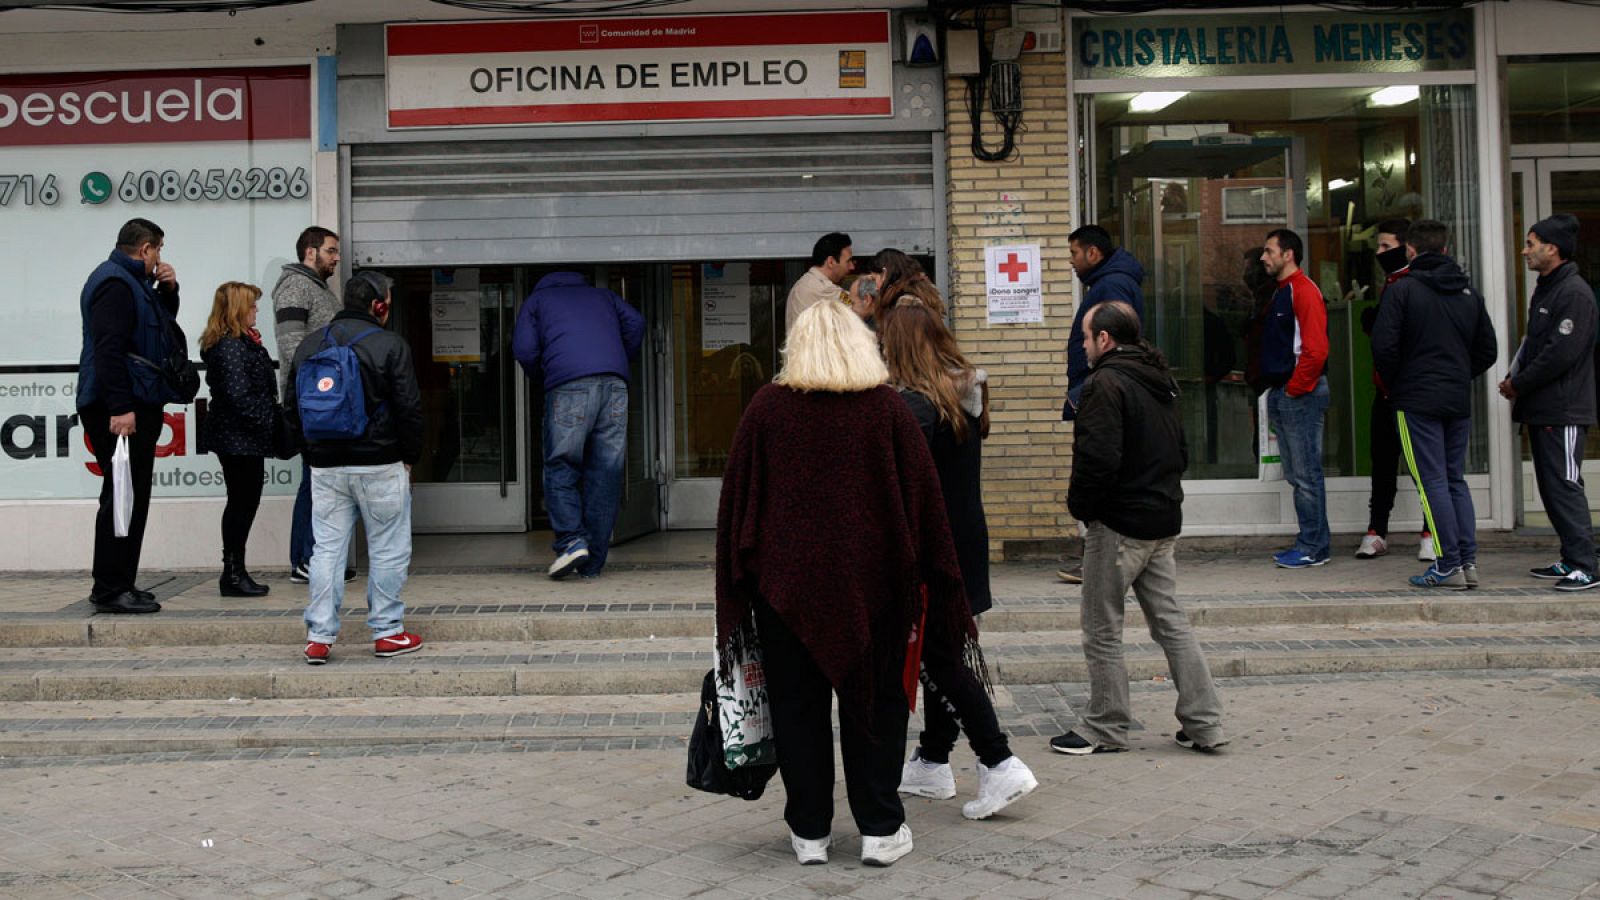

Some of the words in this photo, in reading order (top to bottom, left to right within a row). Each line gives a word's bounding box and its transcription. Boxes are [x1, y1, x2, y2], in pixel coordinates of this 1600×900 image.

[601, 28, 649, 37] Comunidad
[651, 28, 664, 36] de
[665, 27, 696, 35] Madrid
[1079, 25, 1294, 67] CRISTALERIA
[1313, 22, 1470, 64] MENESES
[470, 65, 606, 94] OFICINA
[615, 63, 660, 90] DE
[671, 59, 808, 88] EMPLEO
[0, 173, 60, 206] 716
[118, 167, 310, 203] 608656286
[0, 382, 57, 397] centro
[62, 382, 78, 397] d
[0, 398, 209, 477] aral
